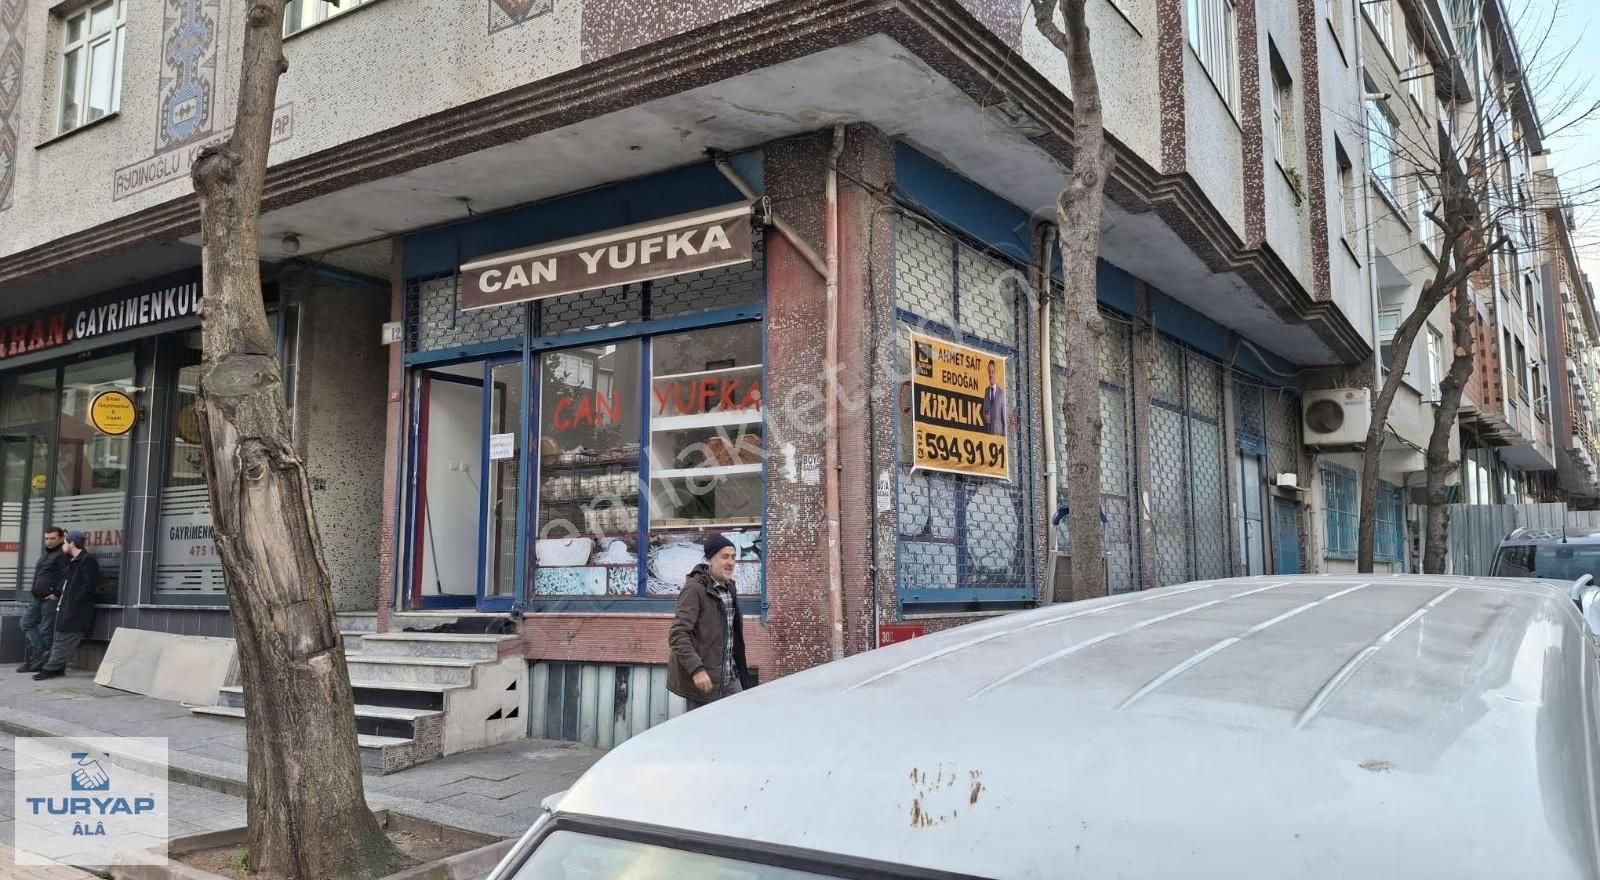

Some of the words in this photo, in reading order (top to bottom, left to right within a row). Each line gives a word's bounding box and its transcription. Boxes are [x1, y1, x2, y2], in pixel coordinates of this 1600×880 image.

[478, 258, 558, 293] CAN
[578, 224, 732, 275] YUFKA
[937, 347, 964, 367] AHMET
[965, 353, 982, 370] SAİT
[941, 369, 979, 392] ERDOĞAN
[552, 390, 622, 432] CAN
[652, 377, 763, 416] YUFKA
[925, 431, 963, 463] 594
[963, 438, 985, 466] 91
[988, 442, 1005, 469] 91
[169, 522, 215, 541] GAYRİMENK
[190, 545, 207, 557] 475
